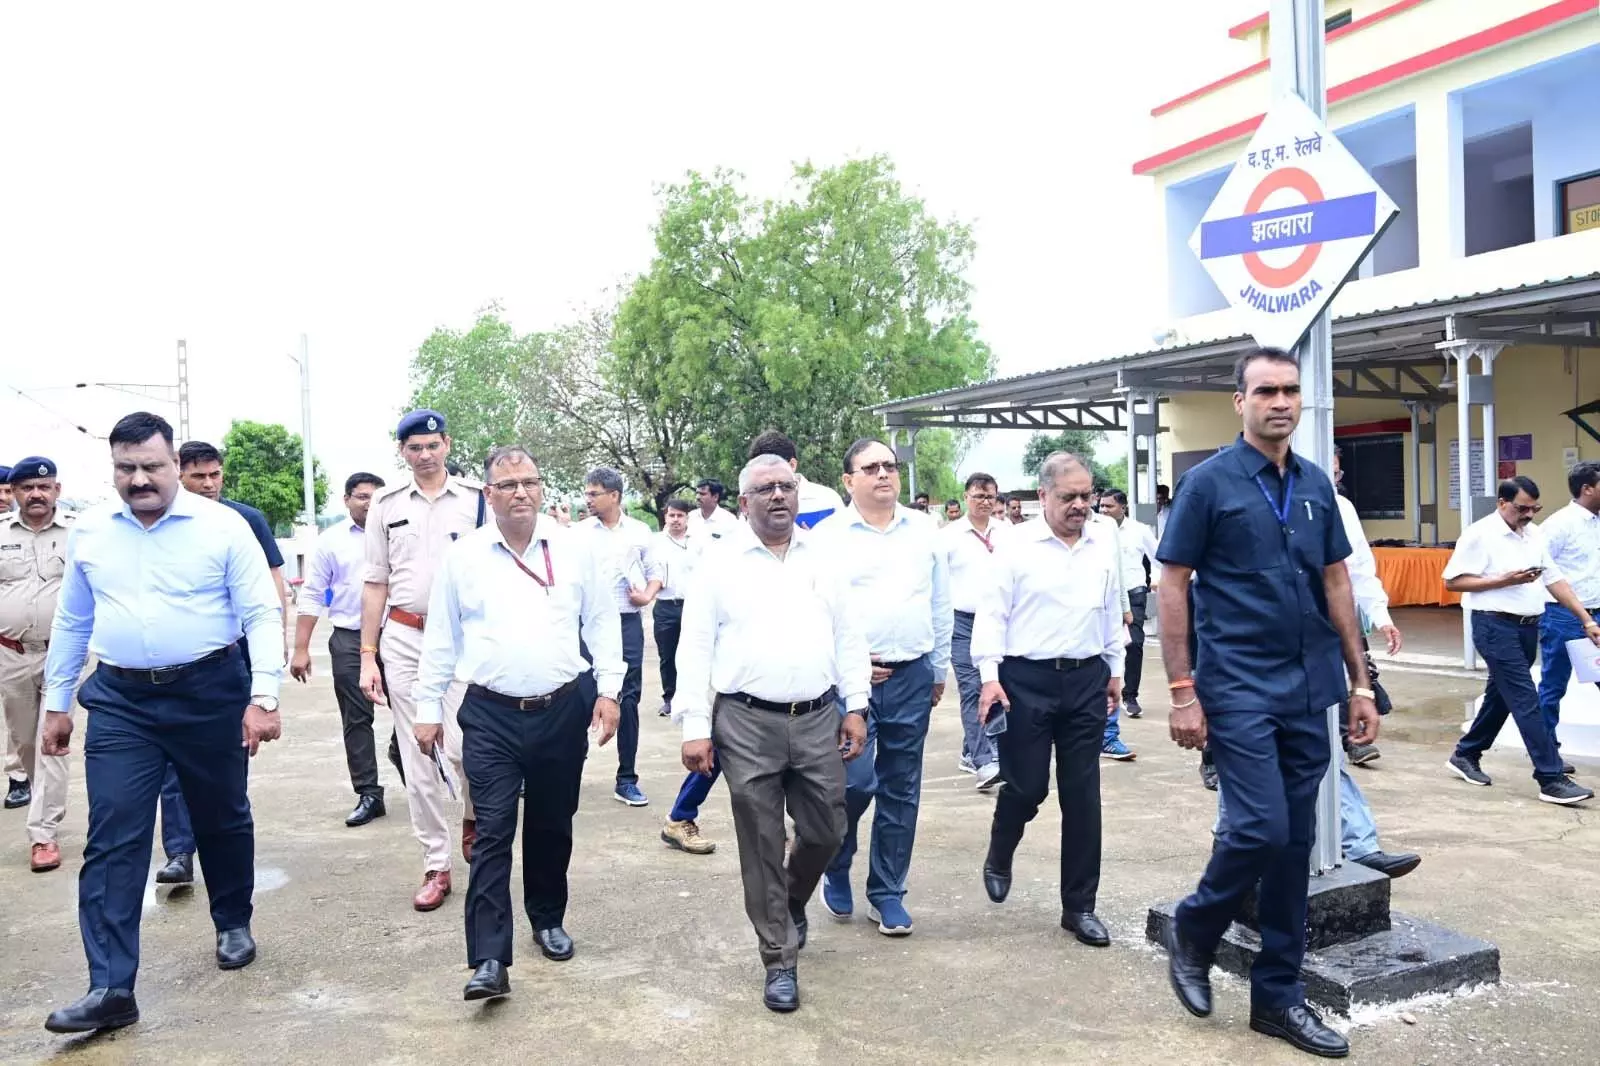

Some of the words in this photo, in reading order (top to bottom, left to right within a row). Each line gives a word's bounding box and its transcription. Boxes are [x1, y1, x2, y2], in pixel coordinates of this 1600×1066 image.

[1248, 144, 1290, 169] द.पू.म.
[1294, 131, 1322, 157] रेलवे
[1251, 211, 1314, 243] झलवारा
[1240, 279, 1323, 313] JHALWARA
